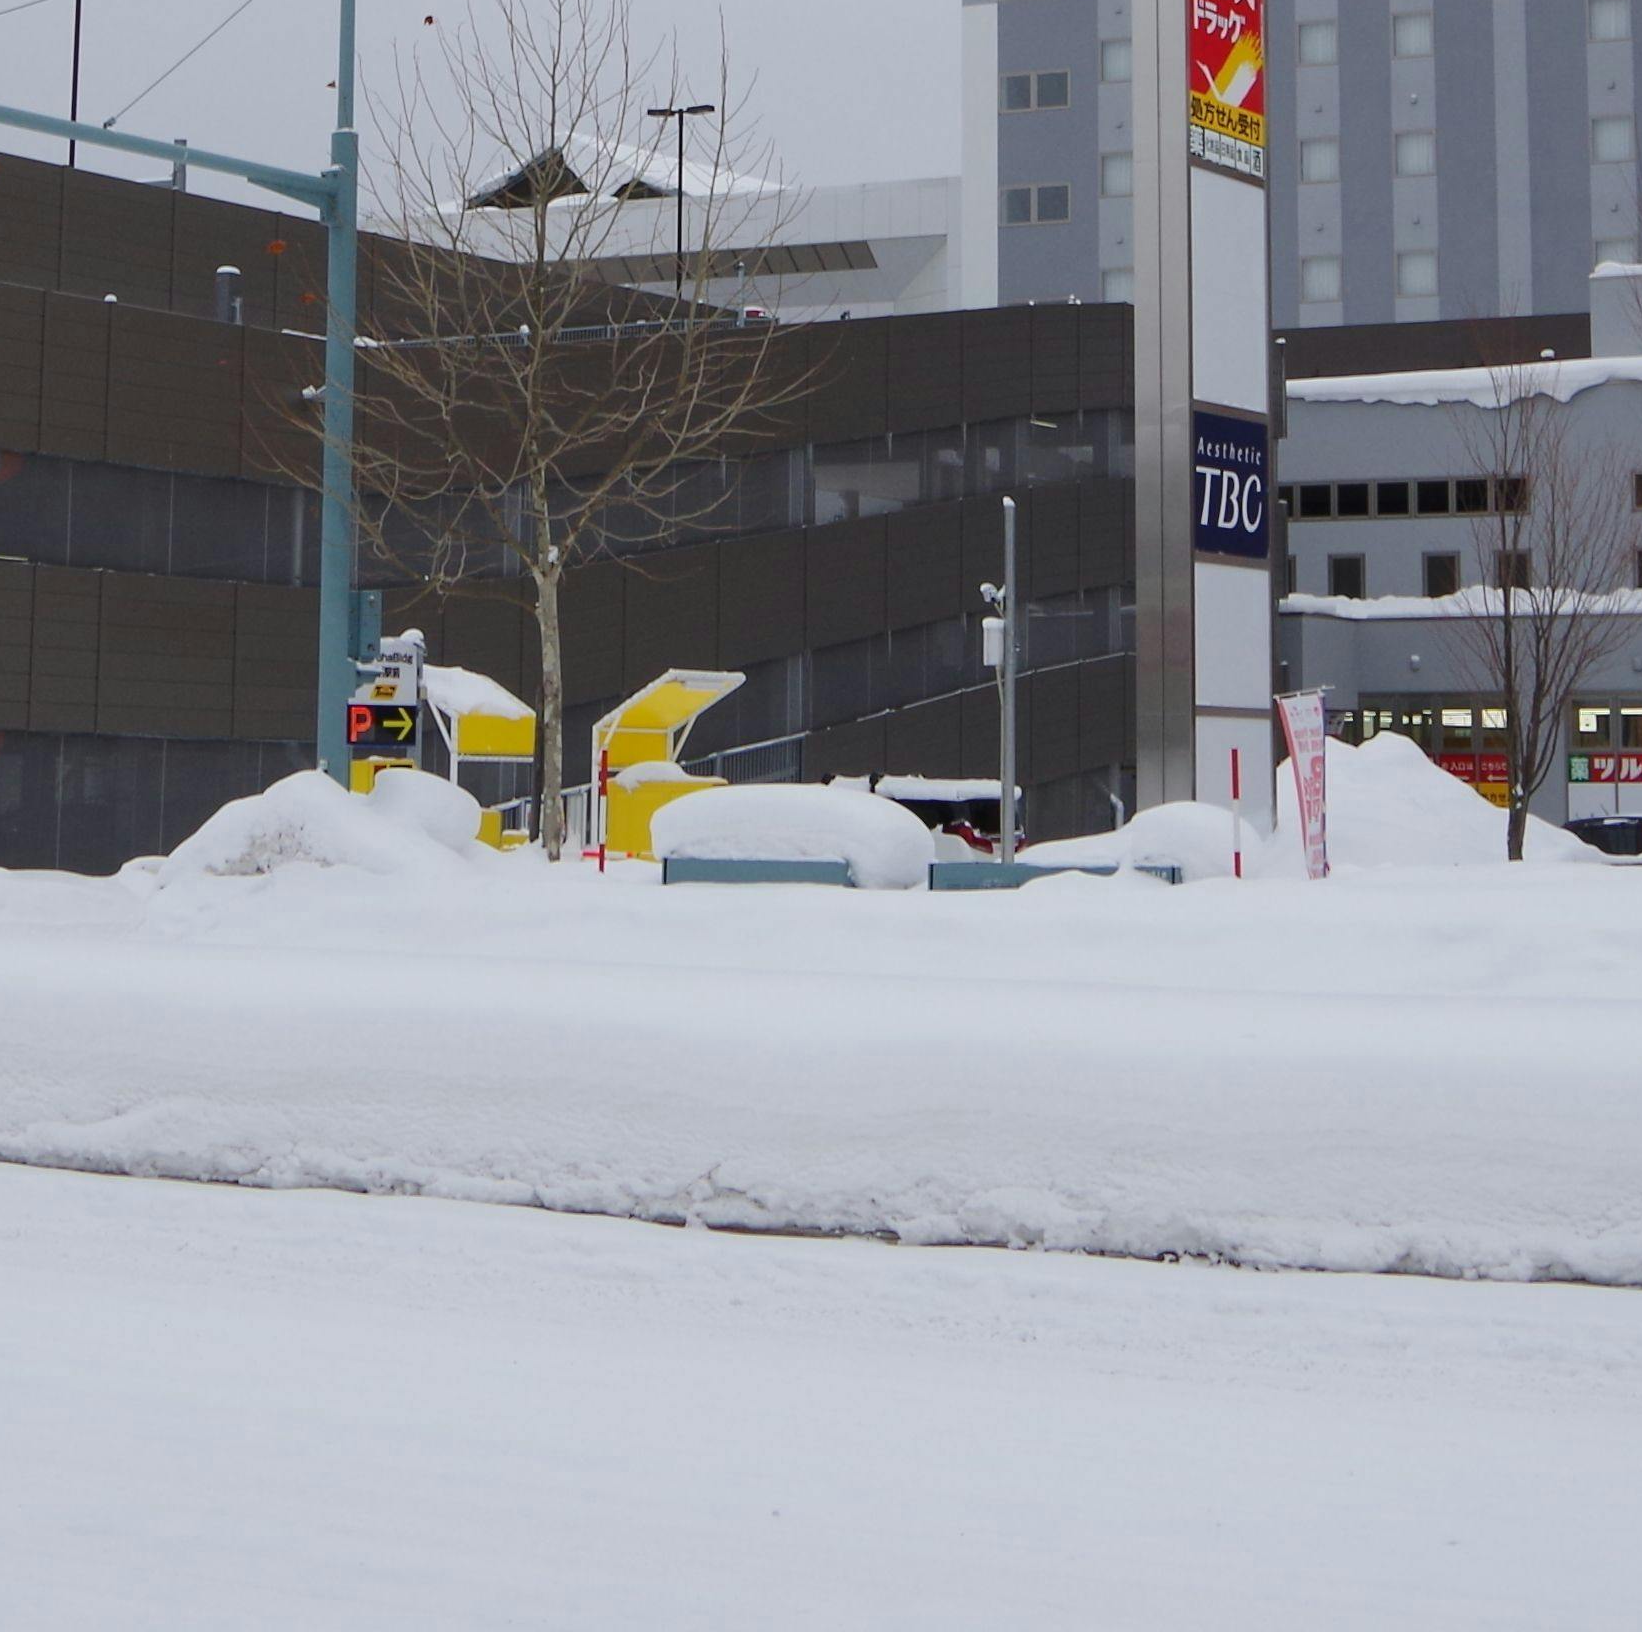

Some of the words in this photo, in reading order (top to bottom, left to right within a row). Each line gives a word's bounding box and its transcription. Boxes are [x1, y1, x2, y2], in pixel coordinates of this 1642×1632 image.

[1191, 95, 1261, 142] 処方せん受付
[1197, 436, 1262, 466] Aesthetic
[1195, 465, 1262, 533] TBC
[349, 706, 373, 744] P
